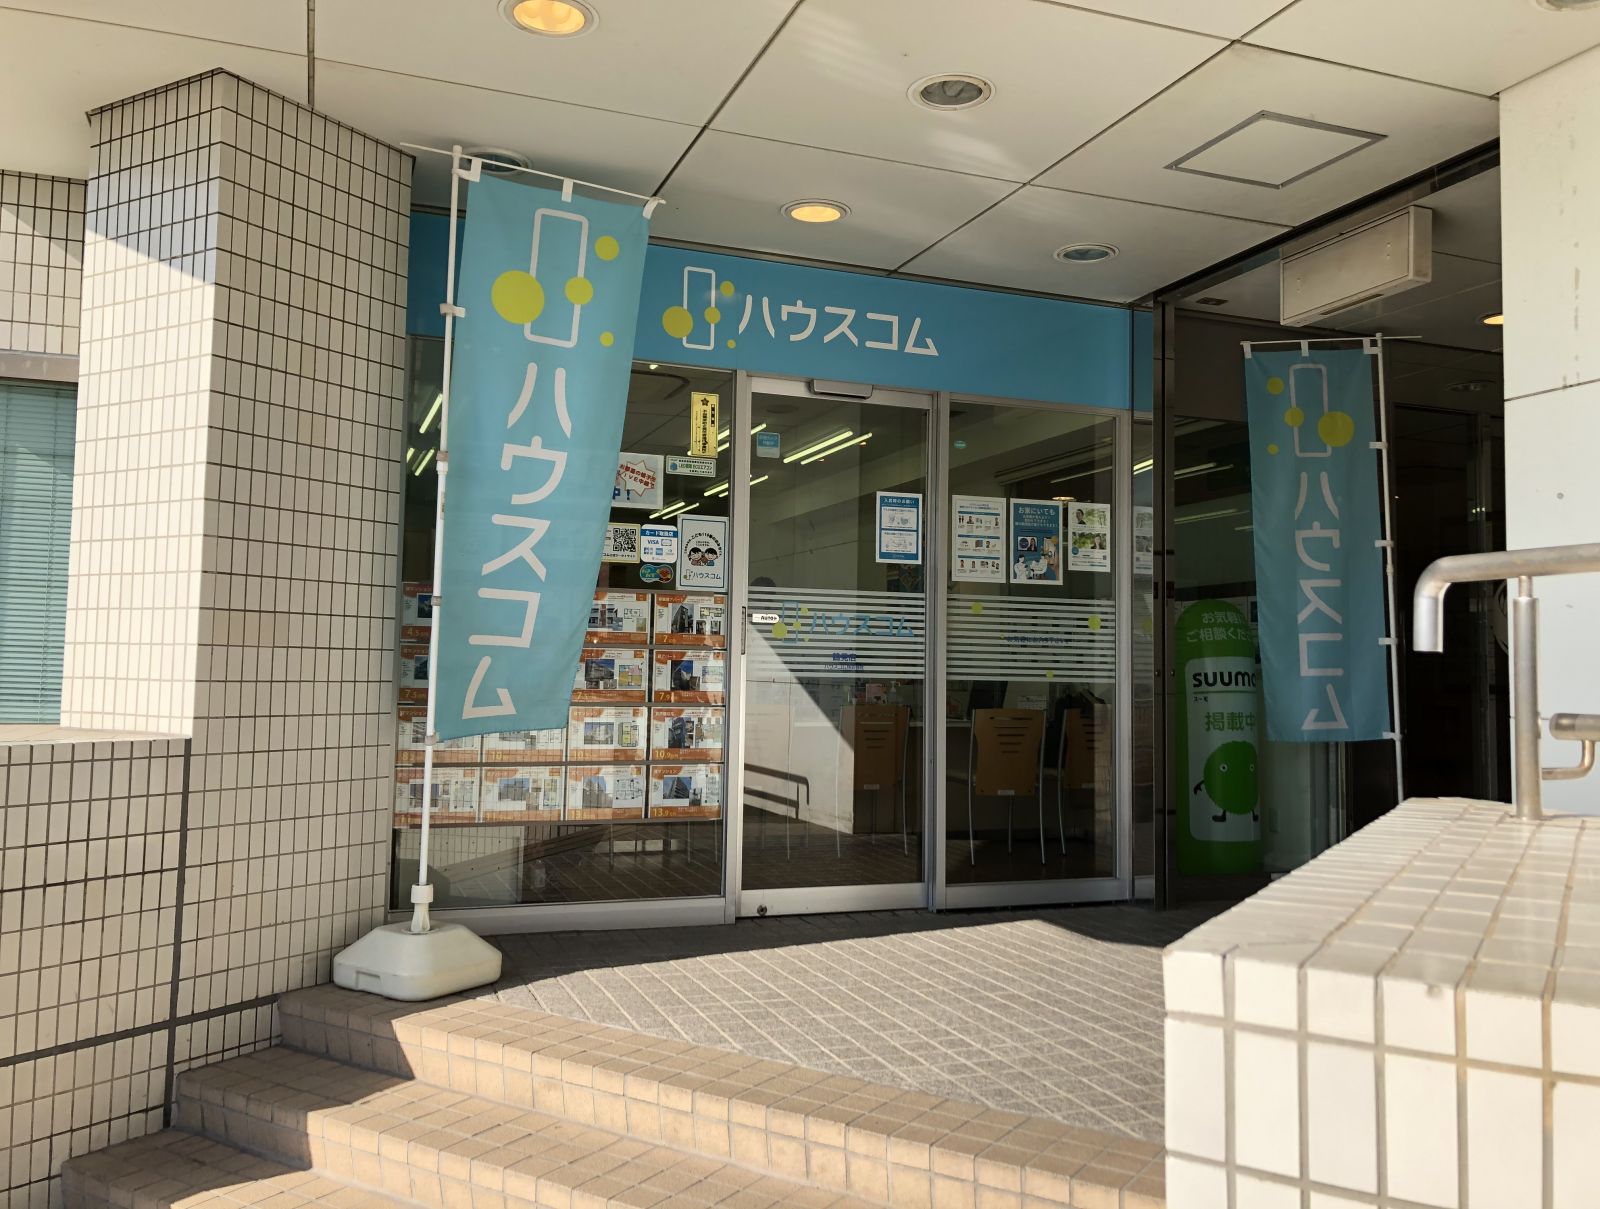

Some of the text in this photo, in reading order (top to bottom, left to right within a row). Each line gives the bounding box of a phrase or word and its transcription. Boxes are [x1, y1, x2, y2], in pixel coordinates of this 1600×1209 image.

[738, 294, 939, 357] ハウスコム
[461, 361, 573, 720] ハウスコム
[692, 572, 721, 580] ハウスコム
[809, 612, 914, 637] ハウスコム
[1201, 611, 1244, 624] お気軽
